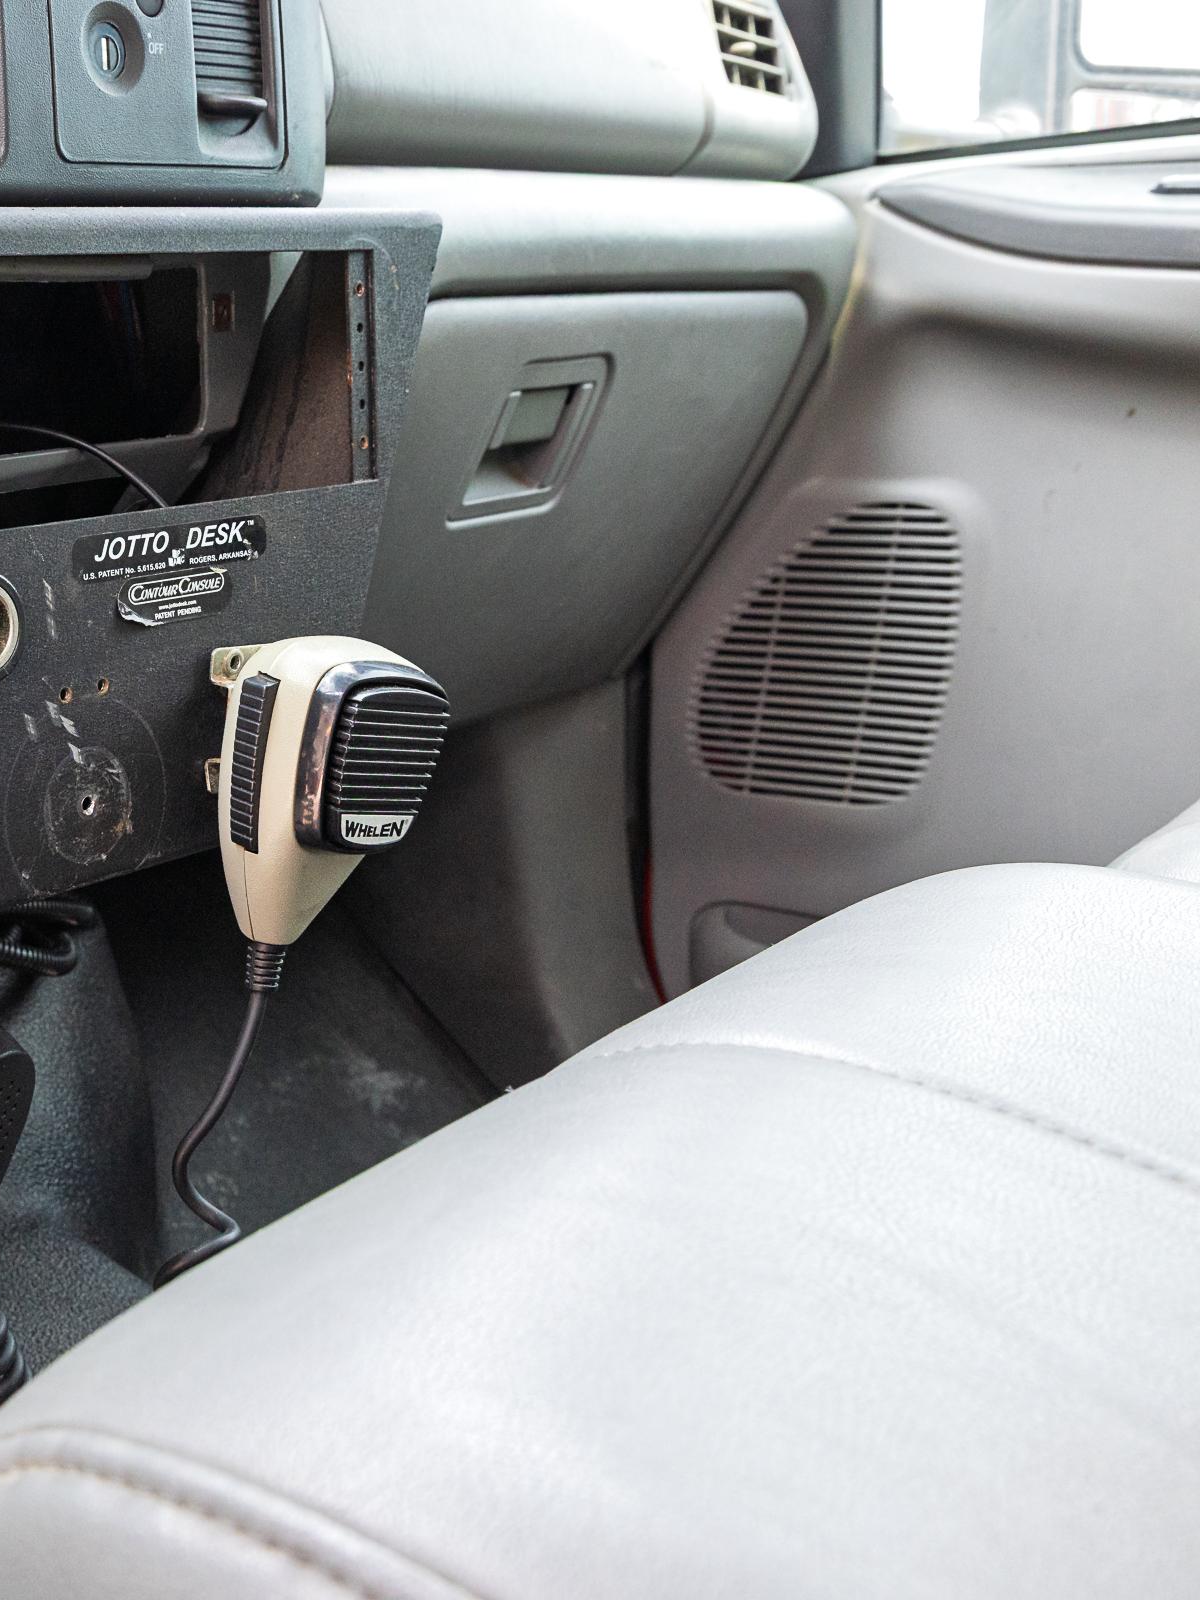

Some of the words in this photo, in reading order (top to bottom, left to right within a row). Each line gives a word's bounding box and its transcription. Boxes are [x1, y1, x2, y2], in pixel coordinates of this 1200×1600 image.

[148, 42, 164, 55] OFF
[94, 530, 170, 562] JOTTO
[189, 554, 218, 565] ROGERS,
[83, 572, 97, 581] U.S.
[98, 568, 124, 578] PATENT
[137, 561, 166, 573] 5,615,620
[154, 610, 176, 620] PATENT
[177, 606, 202, 616] PENDING
[345, 819, 405, 838] WHELEN
